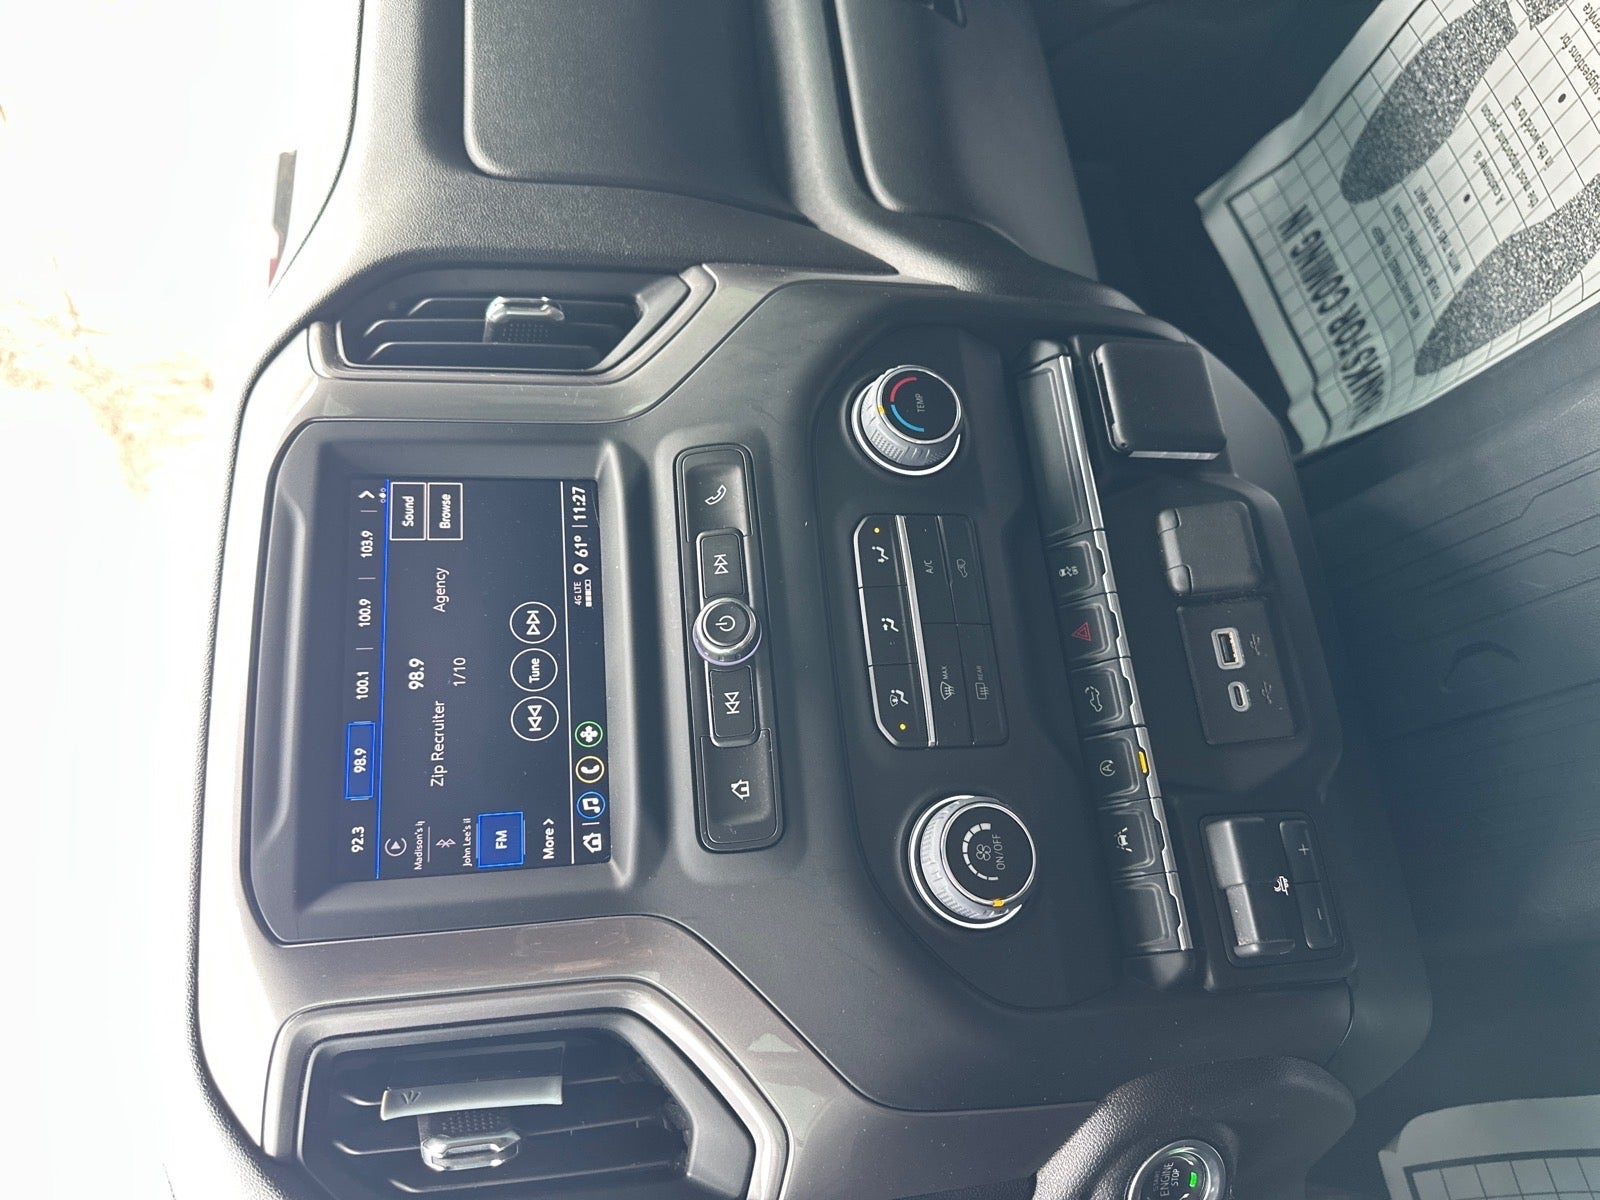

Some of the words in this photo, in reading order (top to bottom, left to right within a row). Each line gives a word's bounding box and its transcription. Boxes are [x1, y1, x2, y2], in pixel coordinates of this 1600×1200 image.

[1560, 33, 1572, 50] for
[1568, 45, 1600, 94] suggestions
[1481, 103, 1502, 132] person
[1519, 108, 1528, 122] to
[1520, 117, 1541, 144] world
[1473, 150, 1482, 164] is
[1495, 130, 1520, 174] important
[1537, 142, 1549, 160] the
[1543, 156, 1554, 171] in
[1479, 159, 1501, 196] customer
[1516, 169, 1532, 192] most
[1495, 194, 1505, 205] A
[1527, 190, 1539, 208] the
[1278, 204, 1313, 242] IN
[1290, 230, 1350, 315] COMING
[1328, 303, 1372, 358] FOR
[915, 393, 926, 413] TEMP
[403, 496, 415, 527] Sound
[439, 494, 451, 529] Browse
[572, 487, 587, 521] 11:27
[361, 530, 374, 558] 103.9
[923, 559, 934, 574] A/C
[434, 567, 449, 612] Agency
[573, 582, 582, 594] LTE
[574, 595, 582, 606] 4G
[359, 599, 371, 627] 100.9
[409, 658, 425, 690] 98.9
[453, 657, 466, 687] 1/10
[529, 658, 541, 683] Tune
[940, 665, 949, 679] MAX
[356, 671, 369, 700] 100.1
[431, 701, 445, 761] Recruiter
[354, 748, 367, 774] 98.9
[431, 765, 446, 787] Zip
[352, 826, 364, 853] 92.3
[462, 825, 471, 845] Lee's
[496, 830, 508, 849] FM
[543, 828, 554, 859] More
[414, 828, 424, 870] Madison's
[462, 846, 472, 866] John
[991, 834, 1005, 870] ON/OFF
[1160, 1162, 1174, 1196] ENGINE
[1172, 1169, 1180, 1186] STOP
